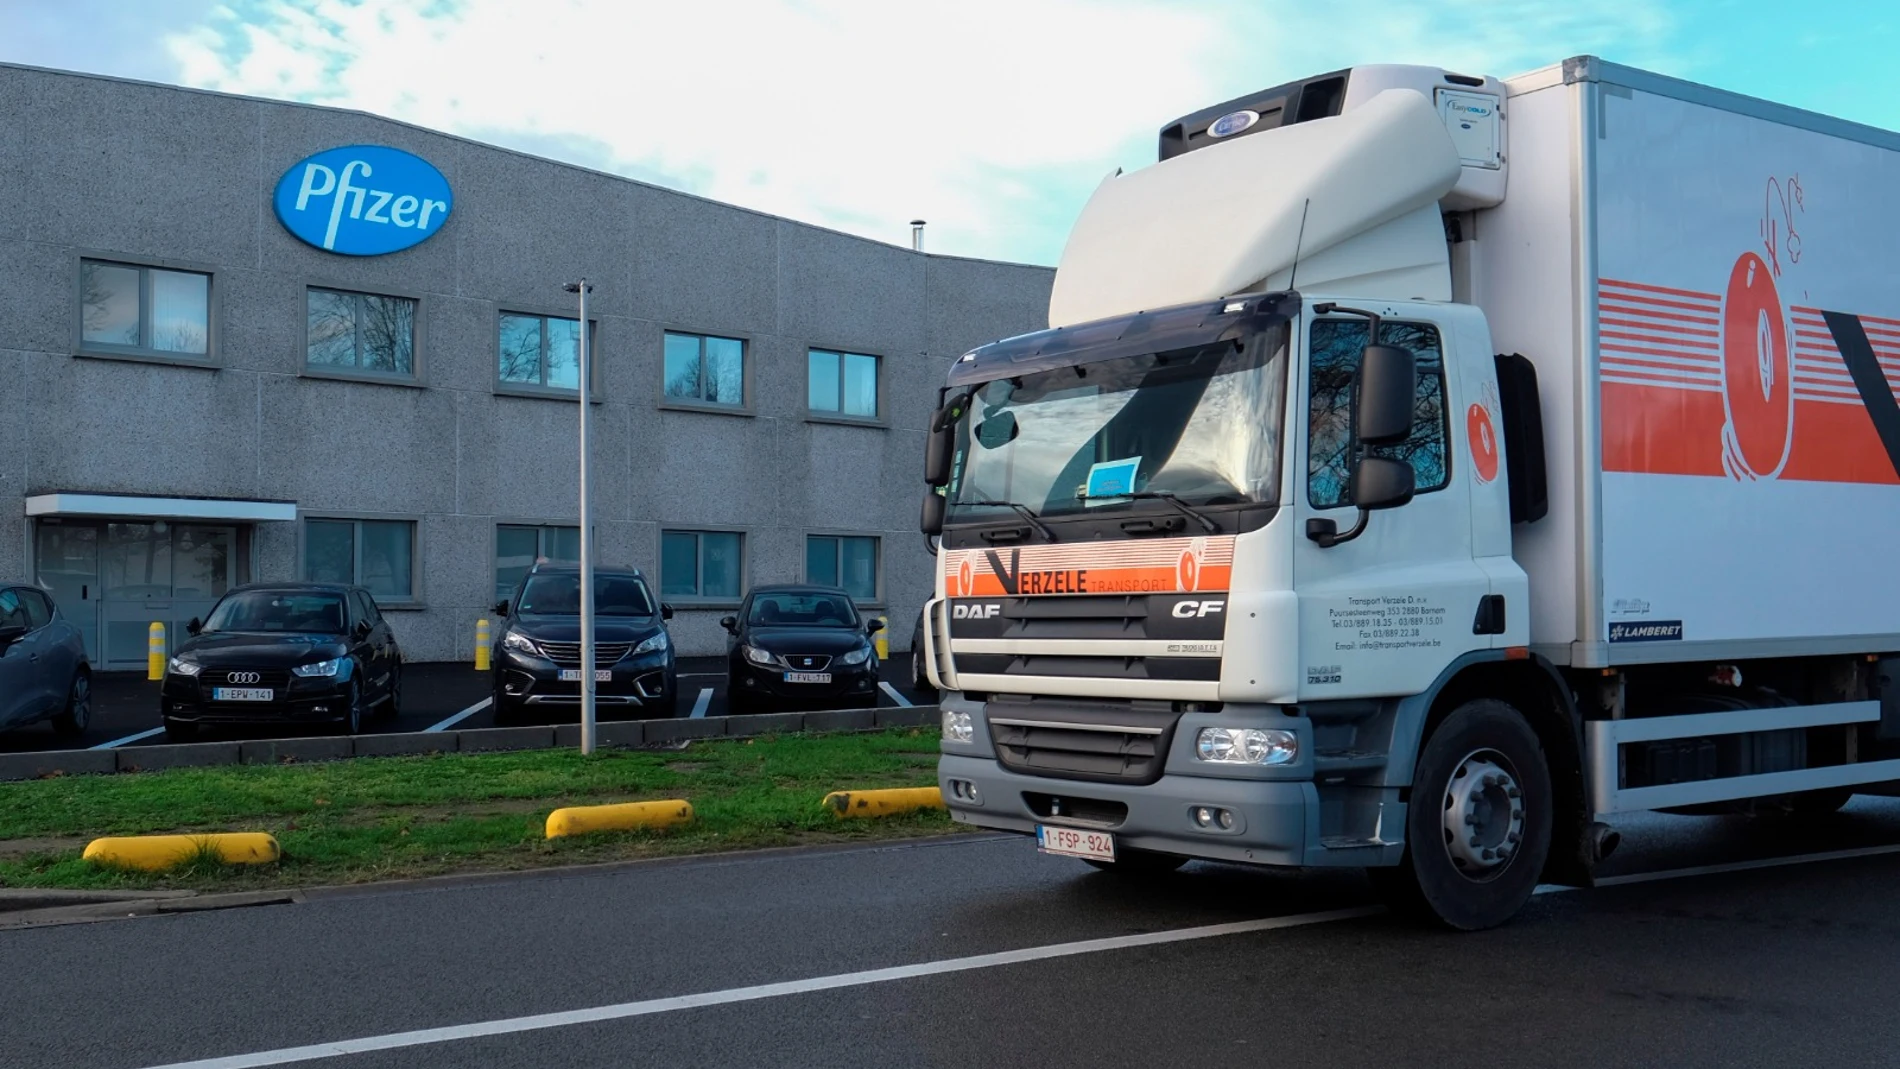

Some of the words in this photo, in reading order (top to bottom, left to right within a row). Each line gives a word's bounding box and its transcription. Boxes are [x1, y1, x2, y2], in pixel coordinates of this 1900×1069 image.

[295, 160, 447, 250] Pfizer
[984, 548, 1087, 595] VERZELE
[1091, 579, 1168, 593] TRANSPORT
[1348, 596, 1381, 607] Transport
[952, 604, 1001, 619] DAF
[1171, 600, 1225, 618] CF
[1401, 606, 1420, 615] 2880
[1359, 630, 1372, 638] Fax
[1624, 625, 1681, 637] LAMBERET
[220, 689, 272, 699] 1-EPW-141
[1045, 829, 1112, 853] 1-FSP-924
